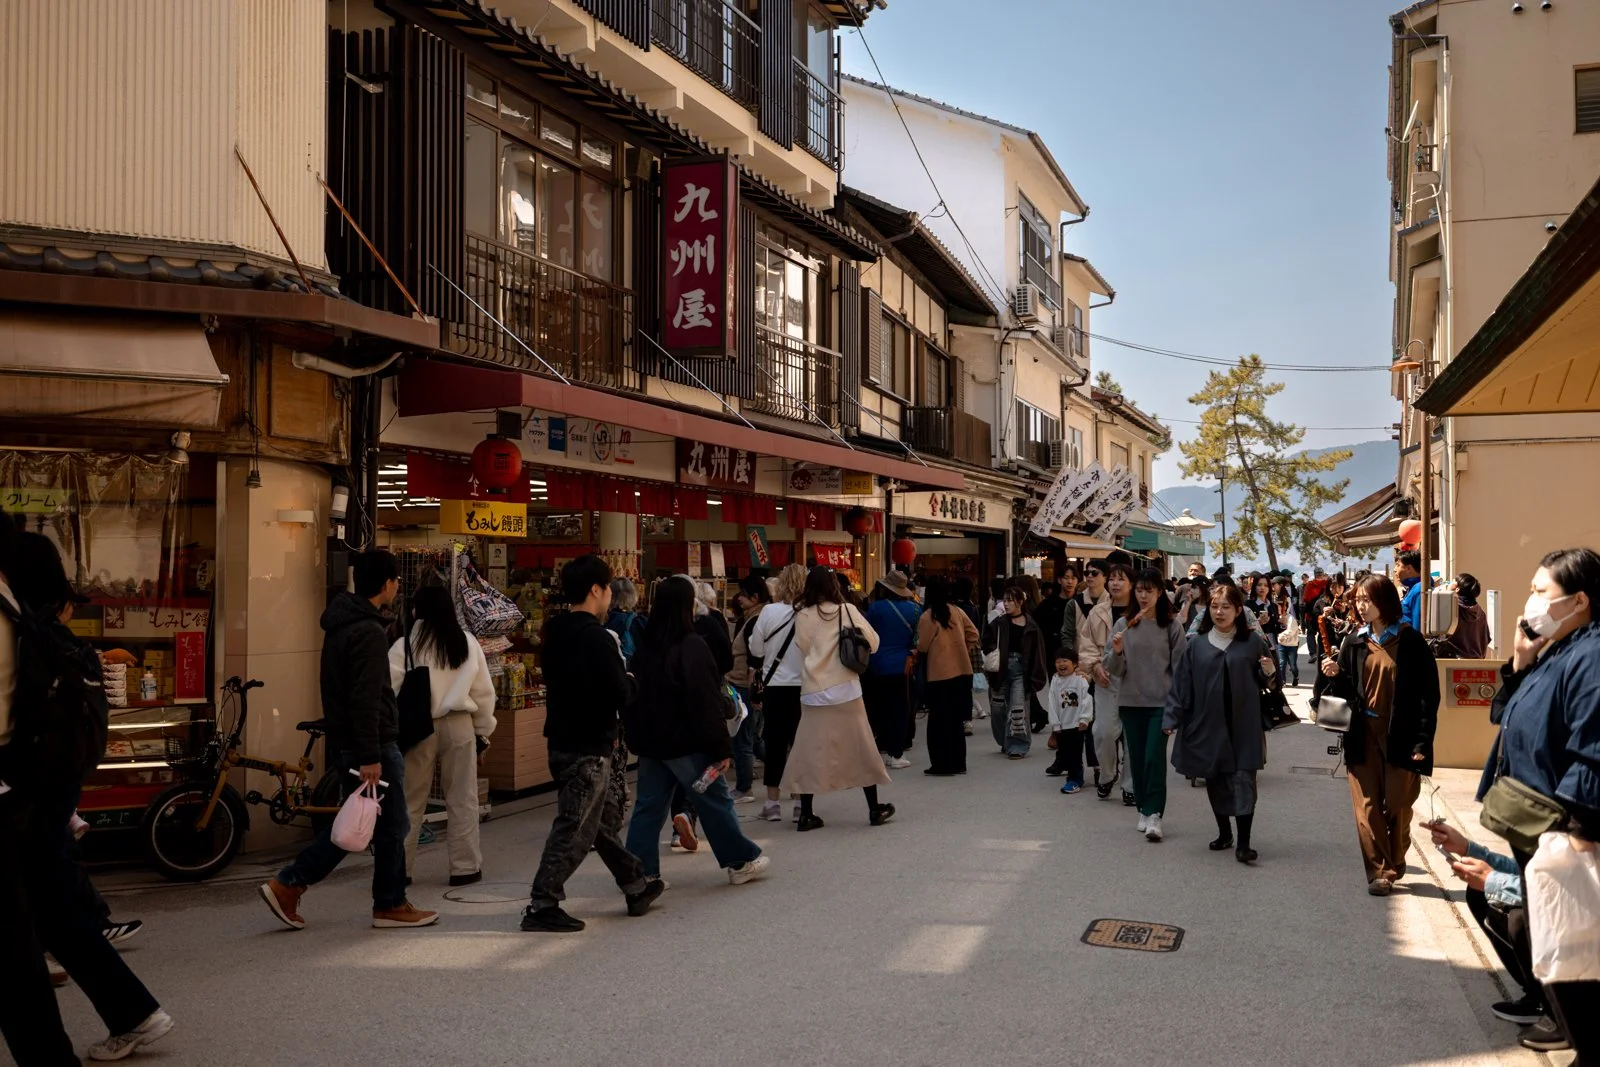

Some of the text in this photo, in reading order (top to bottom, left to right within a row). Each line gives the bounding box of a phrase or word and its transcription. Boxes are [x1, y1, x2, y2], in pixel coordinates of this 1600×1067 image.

[671, 182, 718, 329] 九州屋
[596, 430, 608, 443] JR
[687, 441, 751, 485] 九州屋
[6, 493, 57, 507] クリーム
[466, 510, 524, 533] もみじ饅頭
[751, 531, 767, 565] ラムネ
